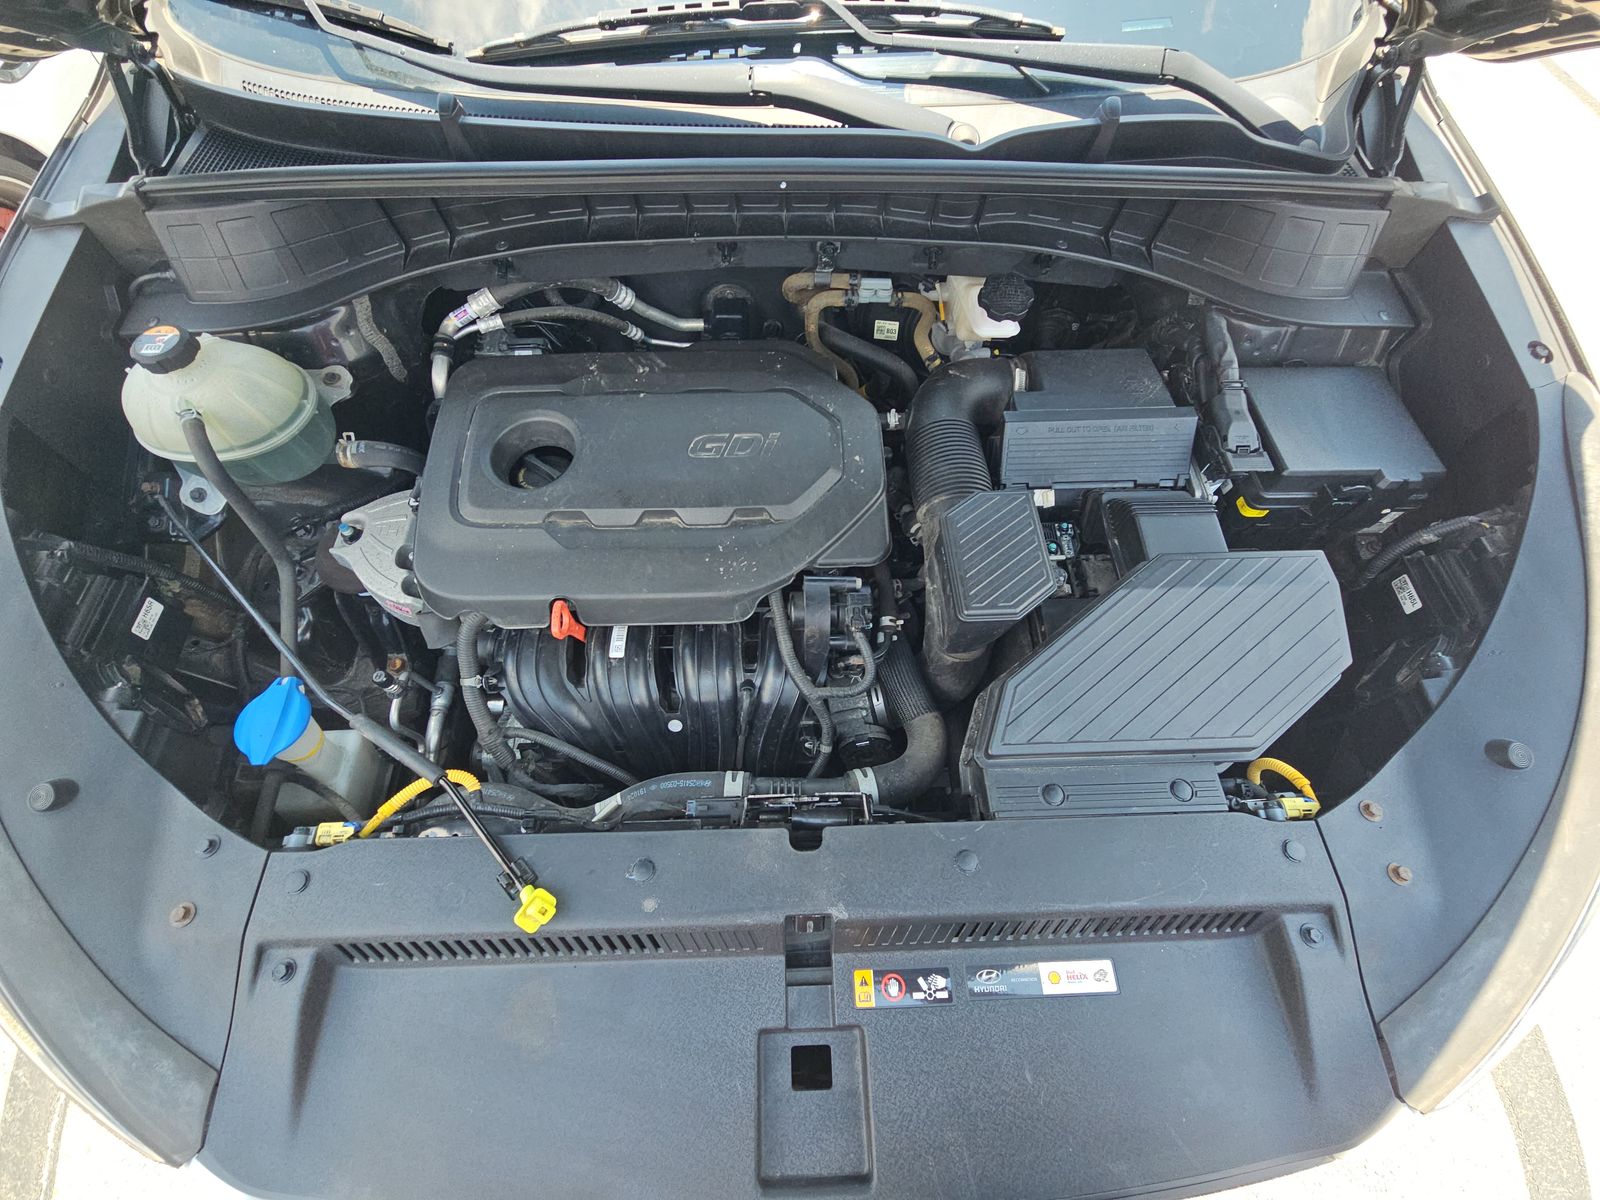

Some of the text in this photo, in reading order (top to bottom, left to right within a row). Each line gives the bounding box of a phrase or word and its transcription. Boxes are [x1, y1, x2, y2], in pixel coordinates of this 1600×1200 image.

[1066, 425, 1081, 433] OUT
[1082, 425, 1091, 433] TO
[973, 984, 1008, 993] HYUNDAI
